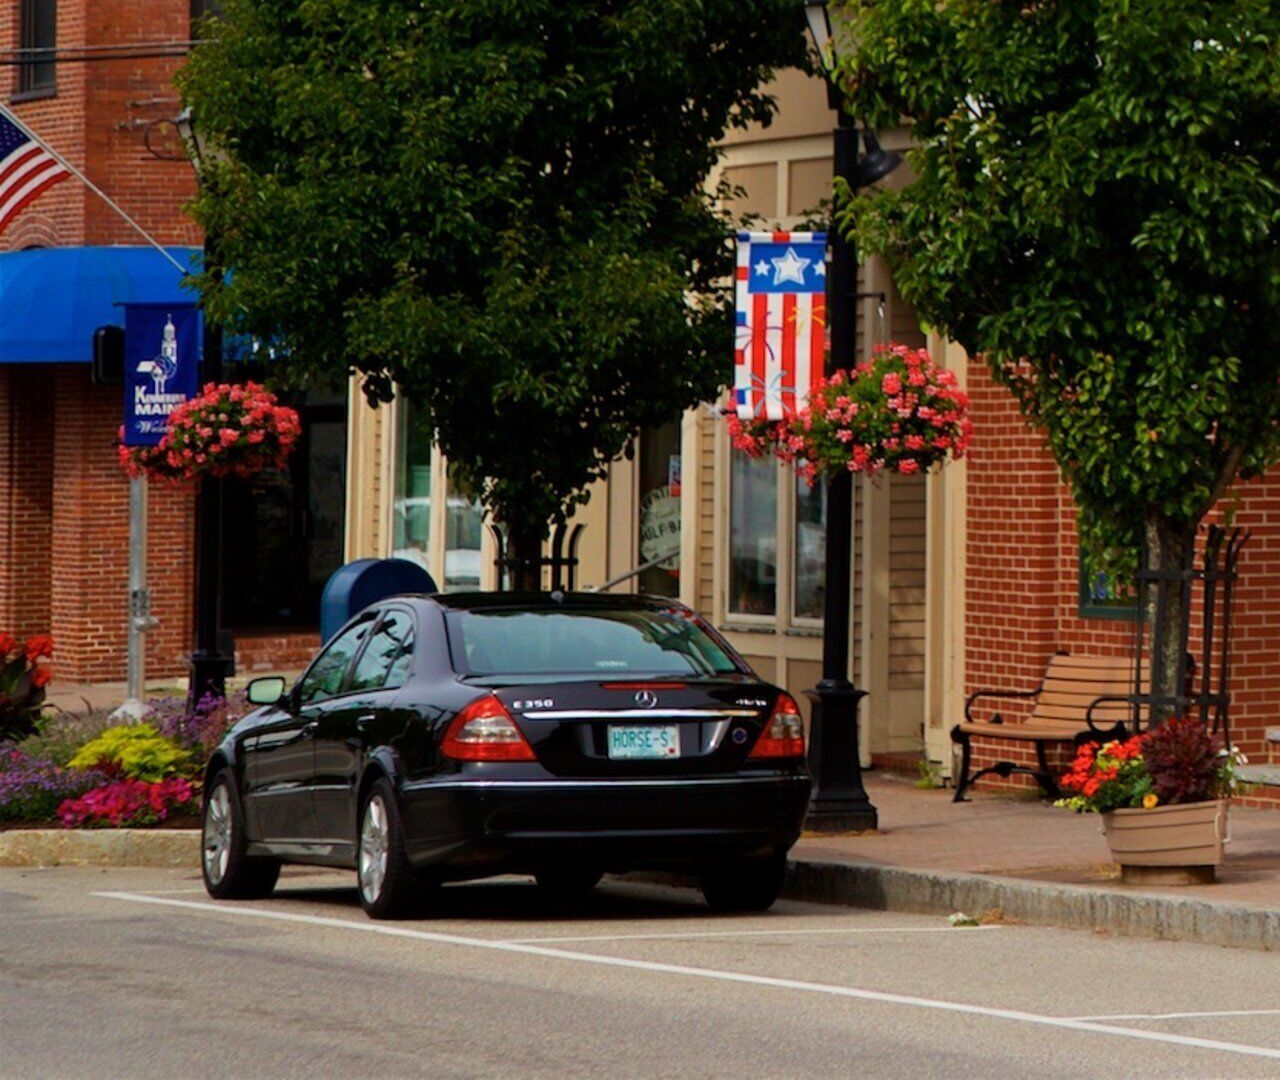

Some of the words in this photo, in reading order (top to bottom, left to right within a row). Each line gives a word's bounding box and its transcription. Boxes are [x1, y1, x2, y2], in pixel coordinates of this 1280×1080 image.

[135, 404, 180, 416] MAIN
[513, 700, 522, 709] E
[613, 730, 668, 748] HORSE-S
